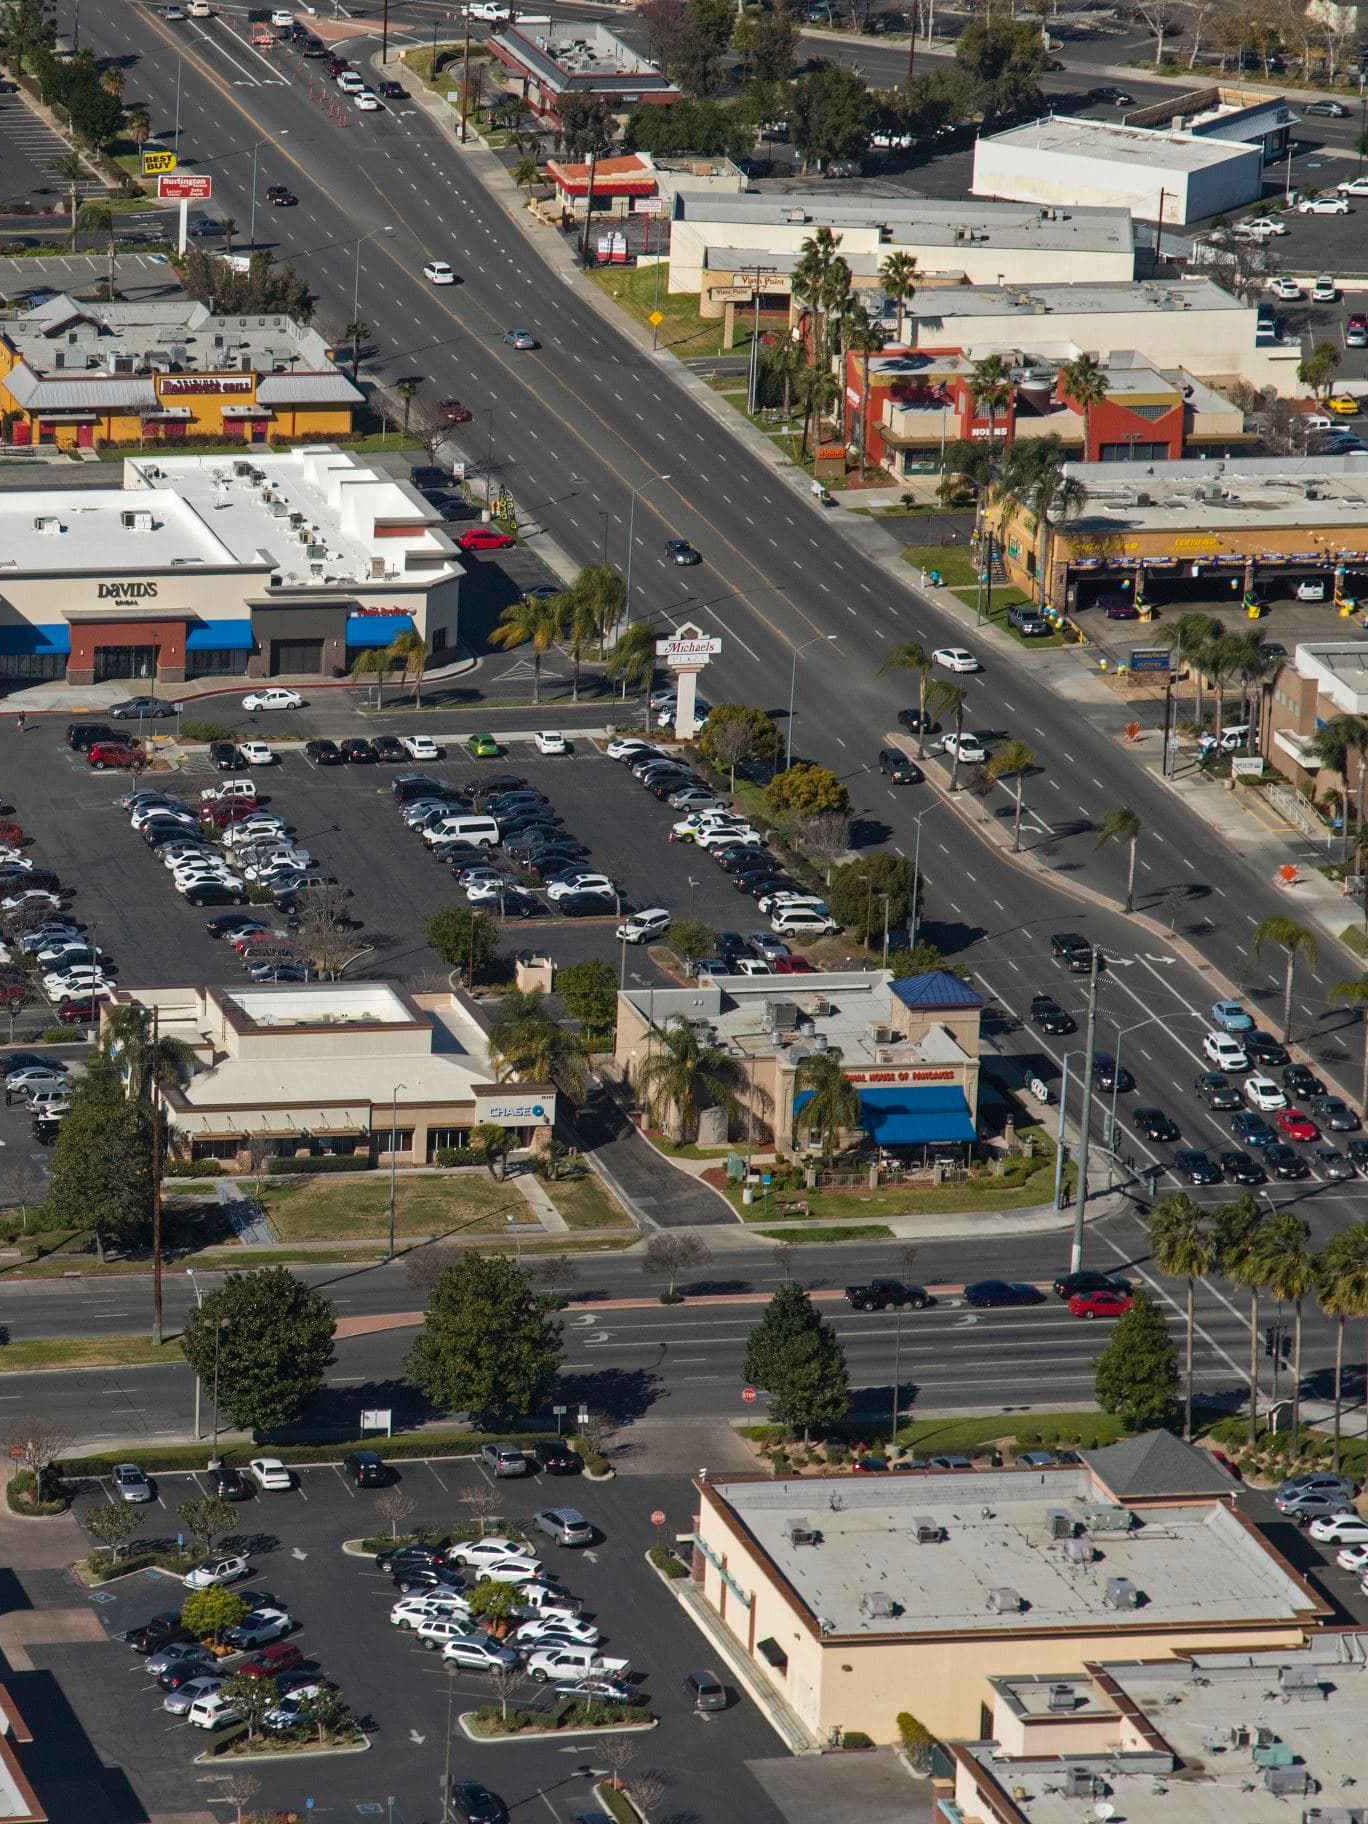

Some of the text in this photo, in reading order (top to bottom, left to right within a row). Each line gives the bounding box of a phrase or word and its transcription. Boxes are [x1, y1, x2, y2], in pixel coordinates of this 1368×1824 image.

[146, 155, 172, 163] BEST
[162, 178, 206, 186] Burlington
[764, 277, 785, 286] Point
[223, 382, 250, 392] GRILL
[972, 428, 1008, 437] NOMS
[665, 642, 715, 653] Michaels
[898, 1072, 909, 1080] OF
[912, 1071, 954, 1080] PANCAKES
[490, 1107, 531, 1117] CHASE
